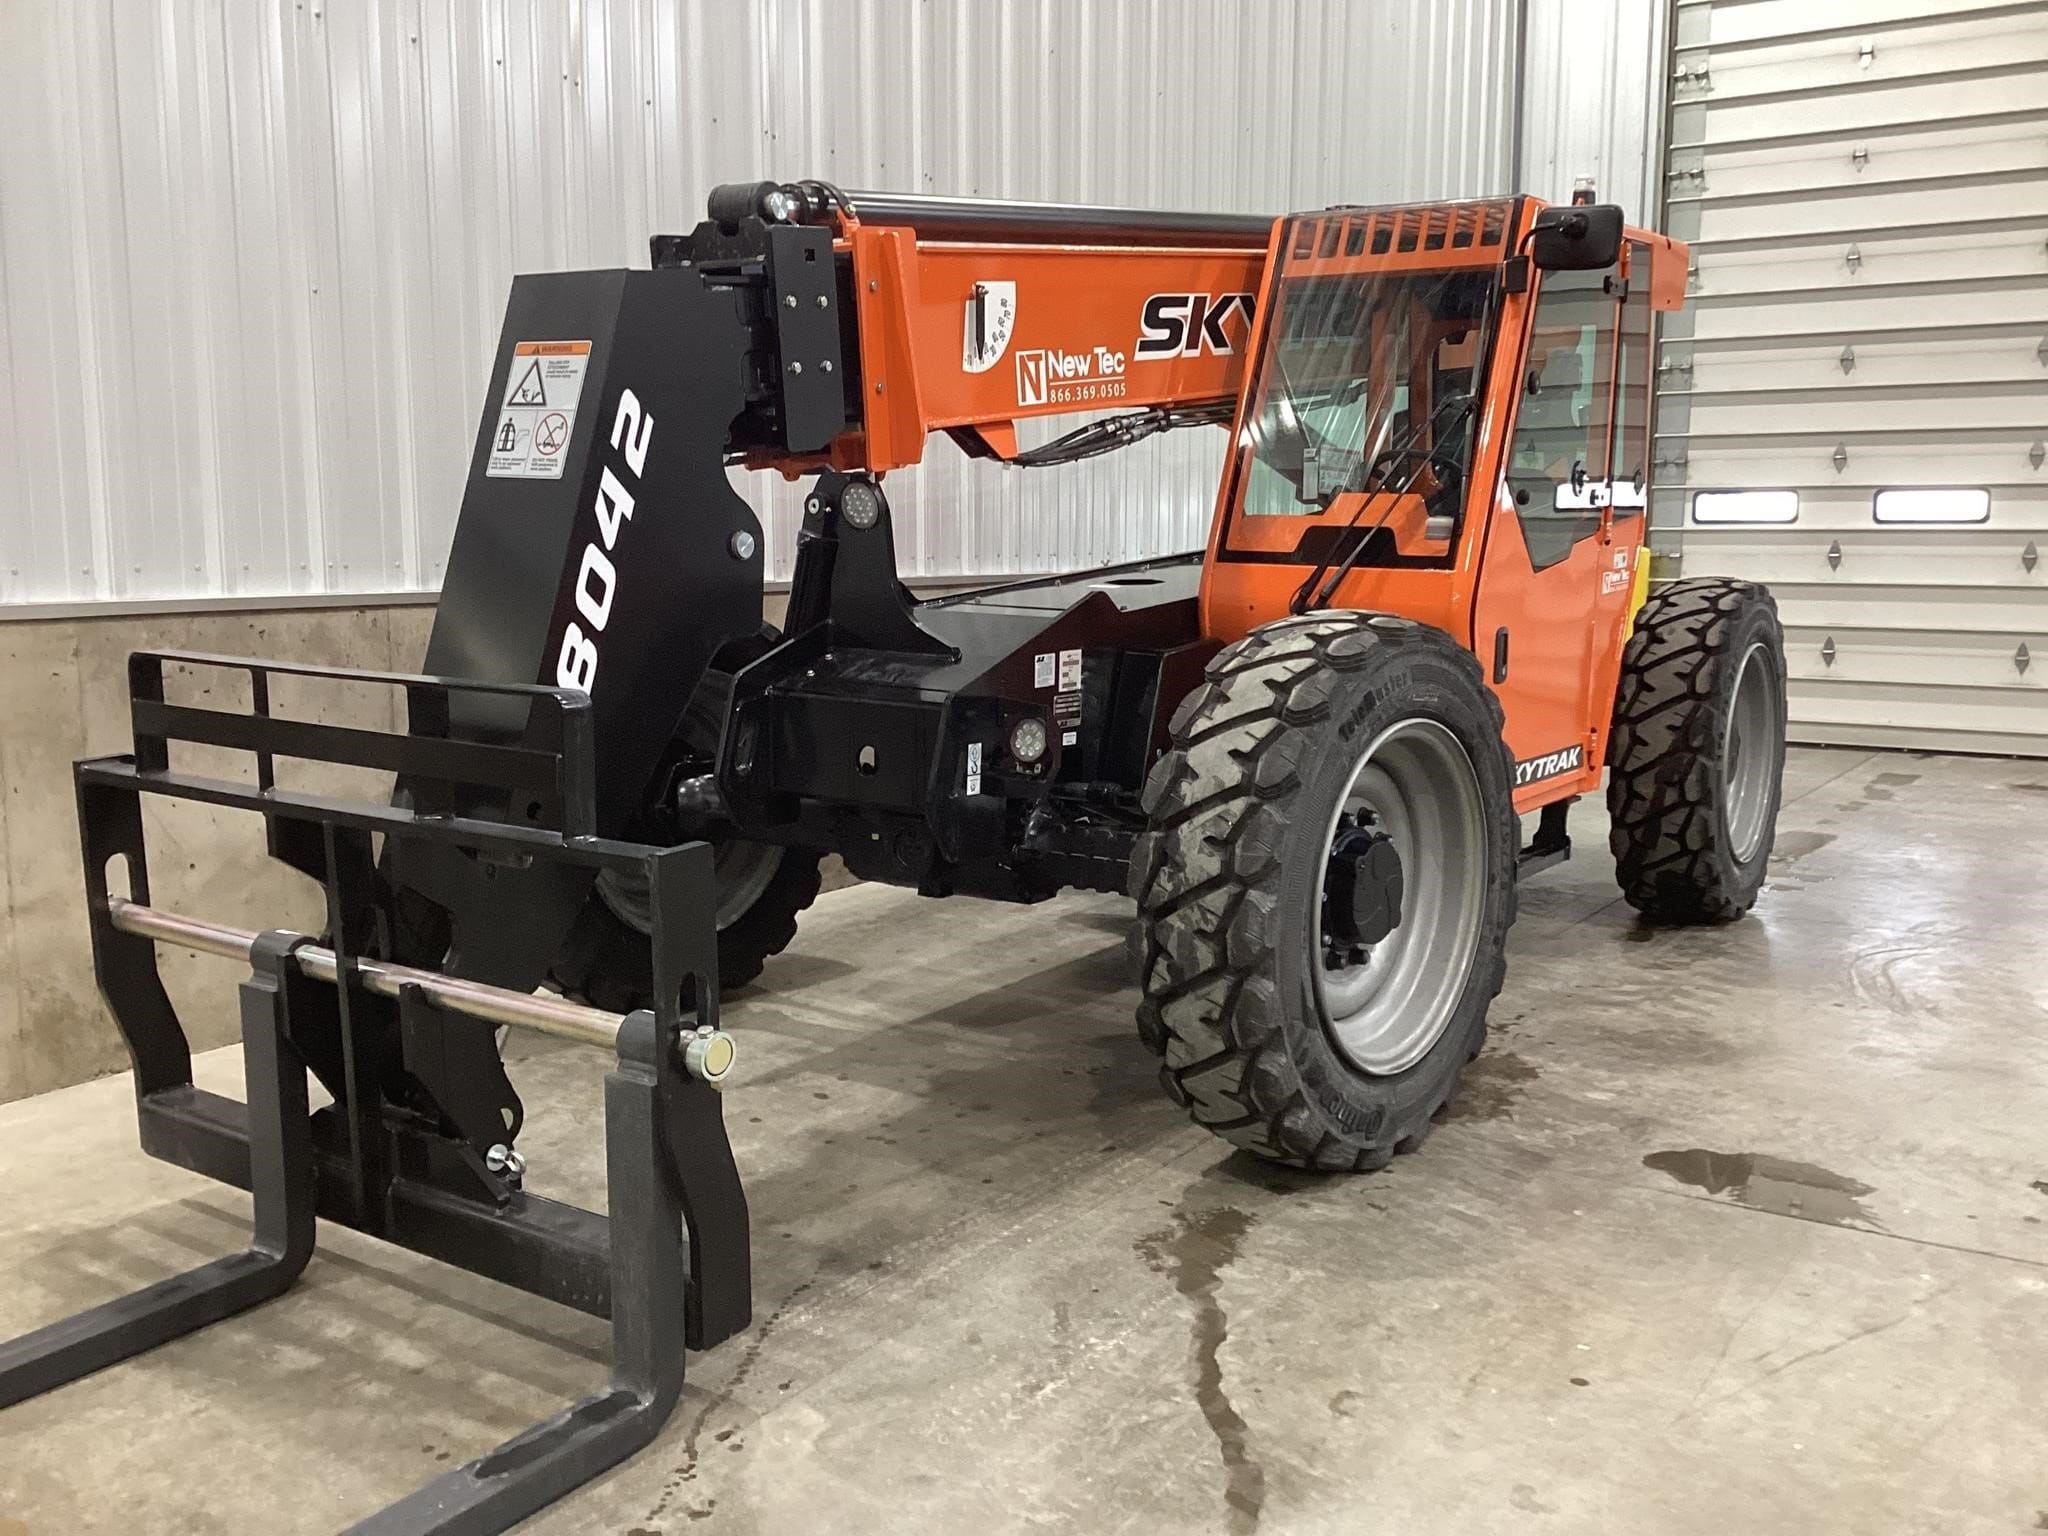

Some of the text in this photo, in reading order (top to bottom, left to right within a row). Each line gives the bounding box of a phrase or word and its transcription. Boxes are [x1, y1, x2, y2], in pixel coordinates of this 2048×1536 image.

[1048, 350, 1092, 379] New
[1093, 346, 1126, 375] Tec
[1050, 382, 1126, 404] 866.369.0505
[557, 388, 654, 698] 8042
[1515, 746, 1581, 785] KYTRAK
